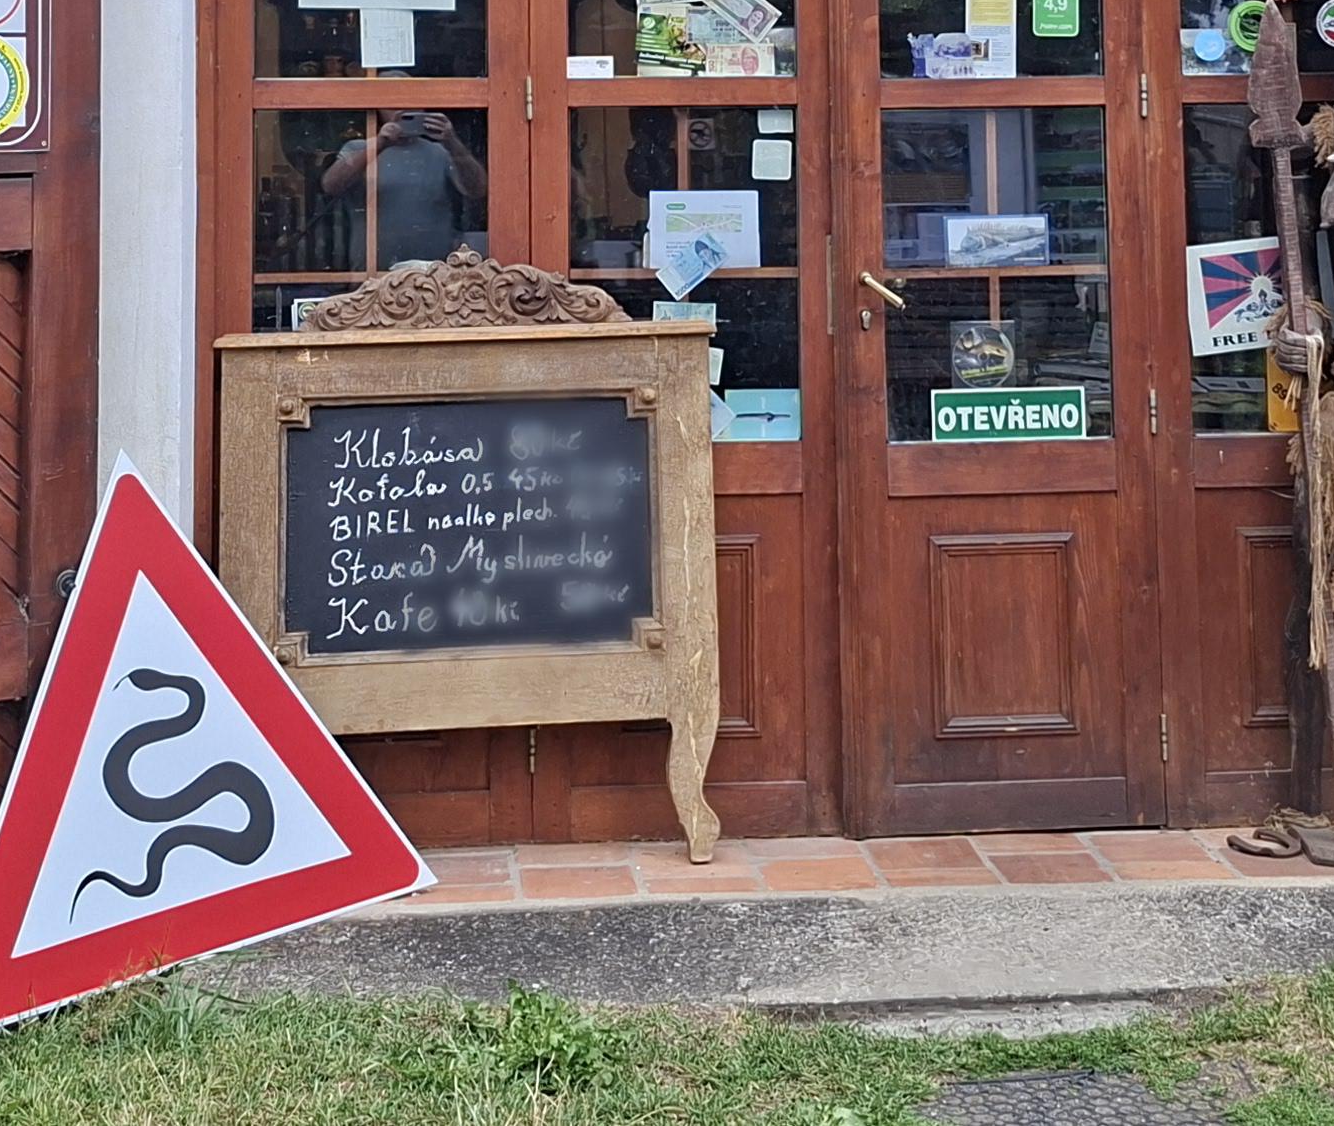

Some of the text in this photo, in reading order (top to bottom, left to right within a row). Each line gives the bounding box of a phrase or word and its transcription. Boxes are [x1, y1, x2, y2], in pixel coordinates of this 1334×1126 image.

[1212, 331, 1258, 348] FREE
[937, 399, 1079, 432] OTEVŘENO
[334, 426, 483, 468] Klobása
[328, 469, 447, 507] Kofola
[329, 508, 415, 542] BIREL
